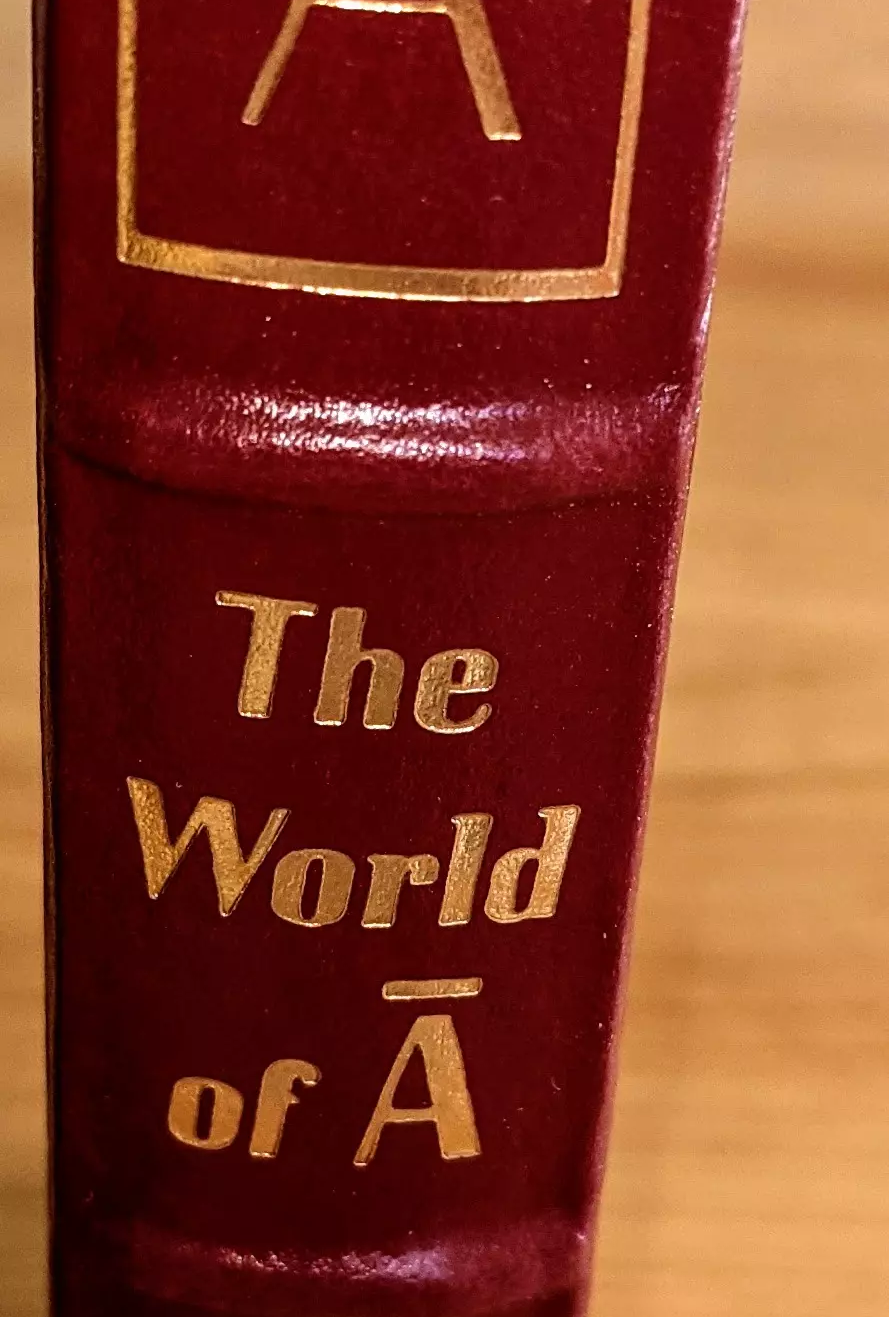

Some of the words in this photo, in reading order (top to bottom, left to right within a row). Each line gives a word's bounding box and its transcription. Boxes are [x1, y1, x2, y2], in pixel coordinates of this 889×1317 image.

[214, 590, 500, 735] The
[126, 775, 582, 929] World
[166, 1058, 323, 1160] of
